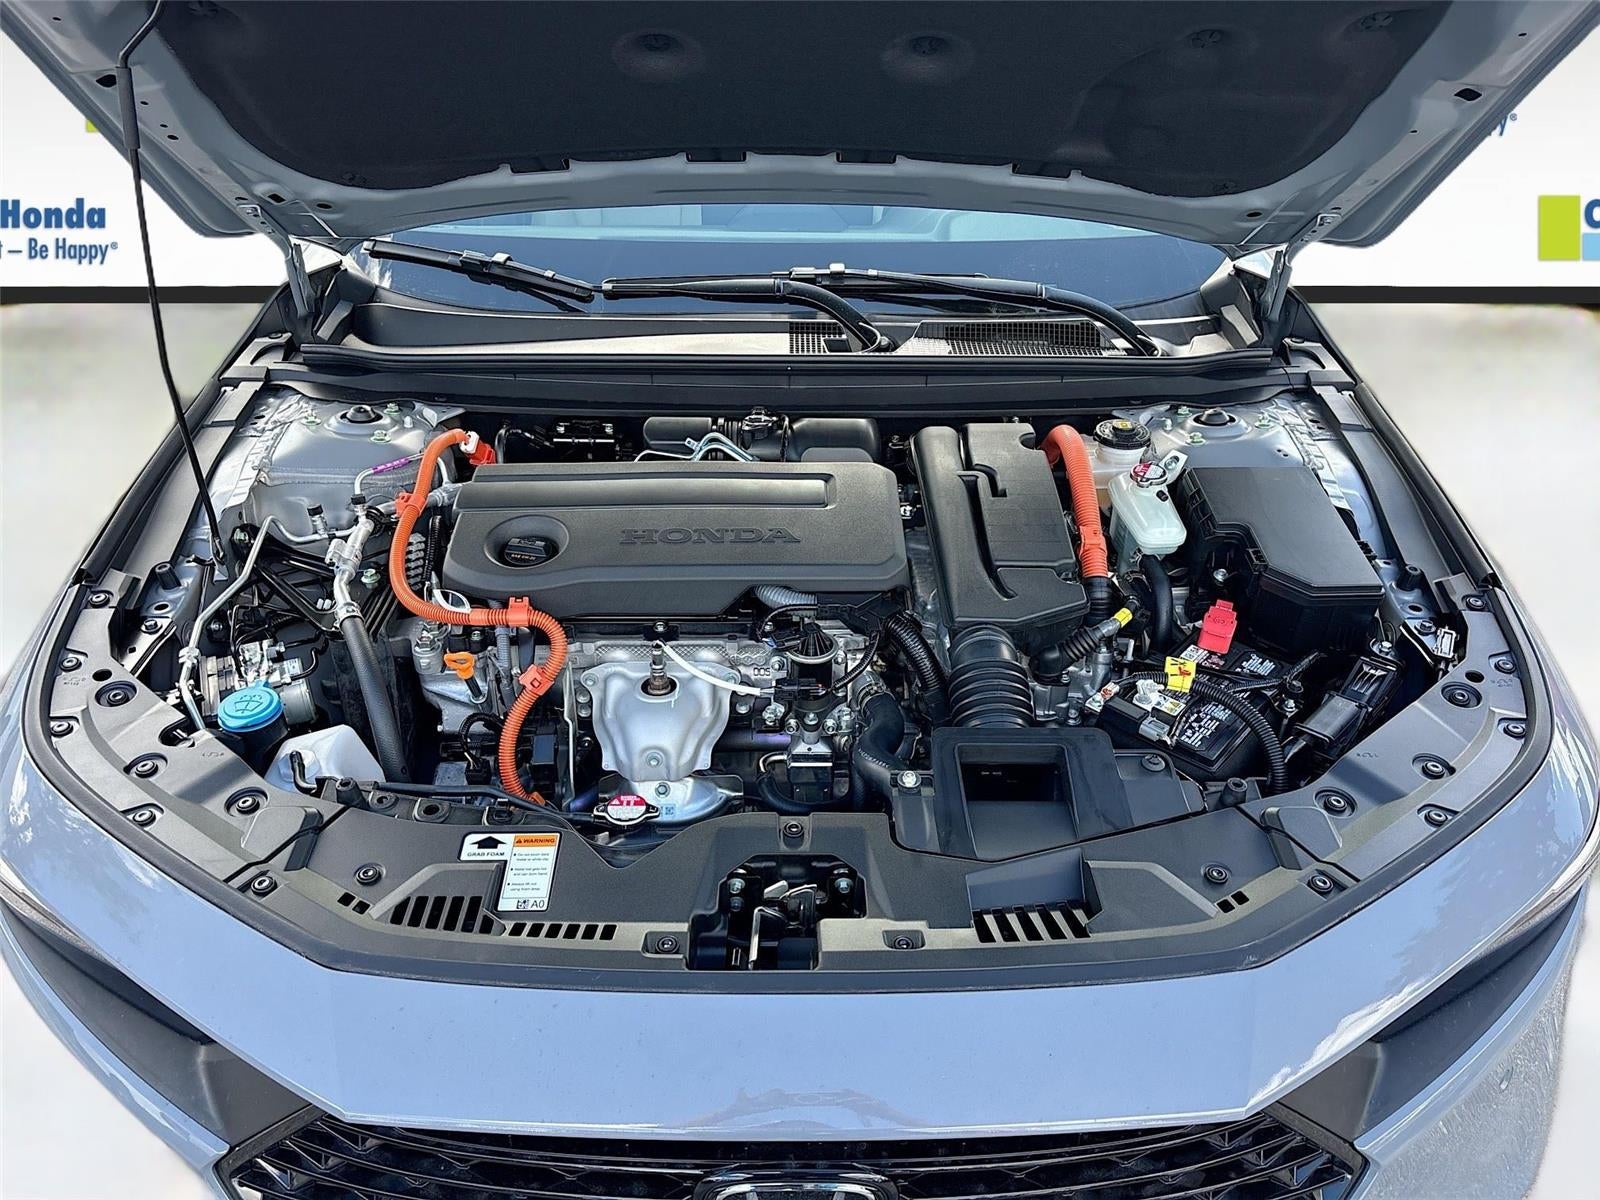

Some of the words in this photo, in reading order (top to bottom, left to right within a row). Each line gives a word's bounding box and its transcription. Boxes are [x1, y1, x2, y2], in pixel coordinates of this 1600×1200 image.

[0, 198, 106, 229] Honda
[28, 238, 49, 260] Be
[619, 526, 802, 546] HONDA
